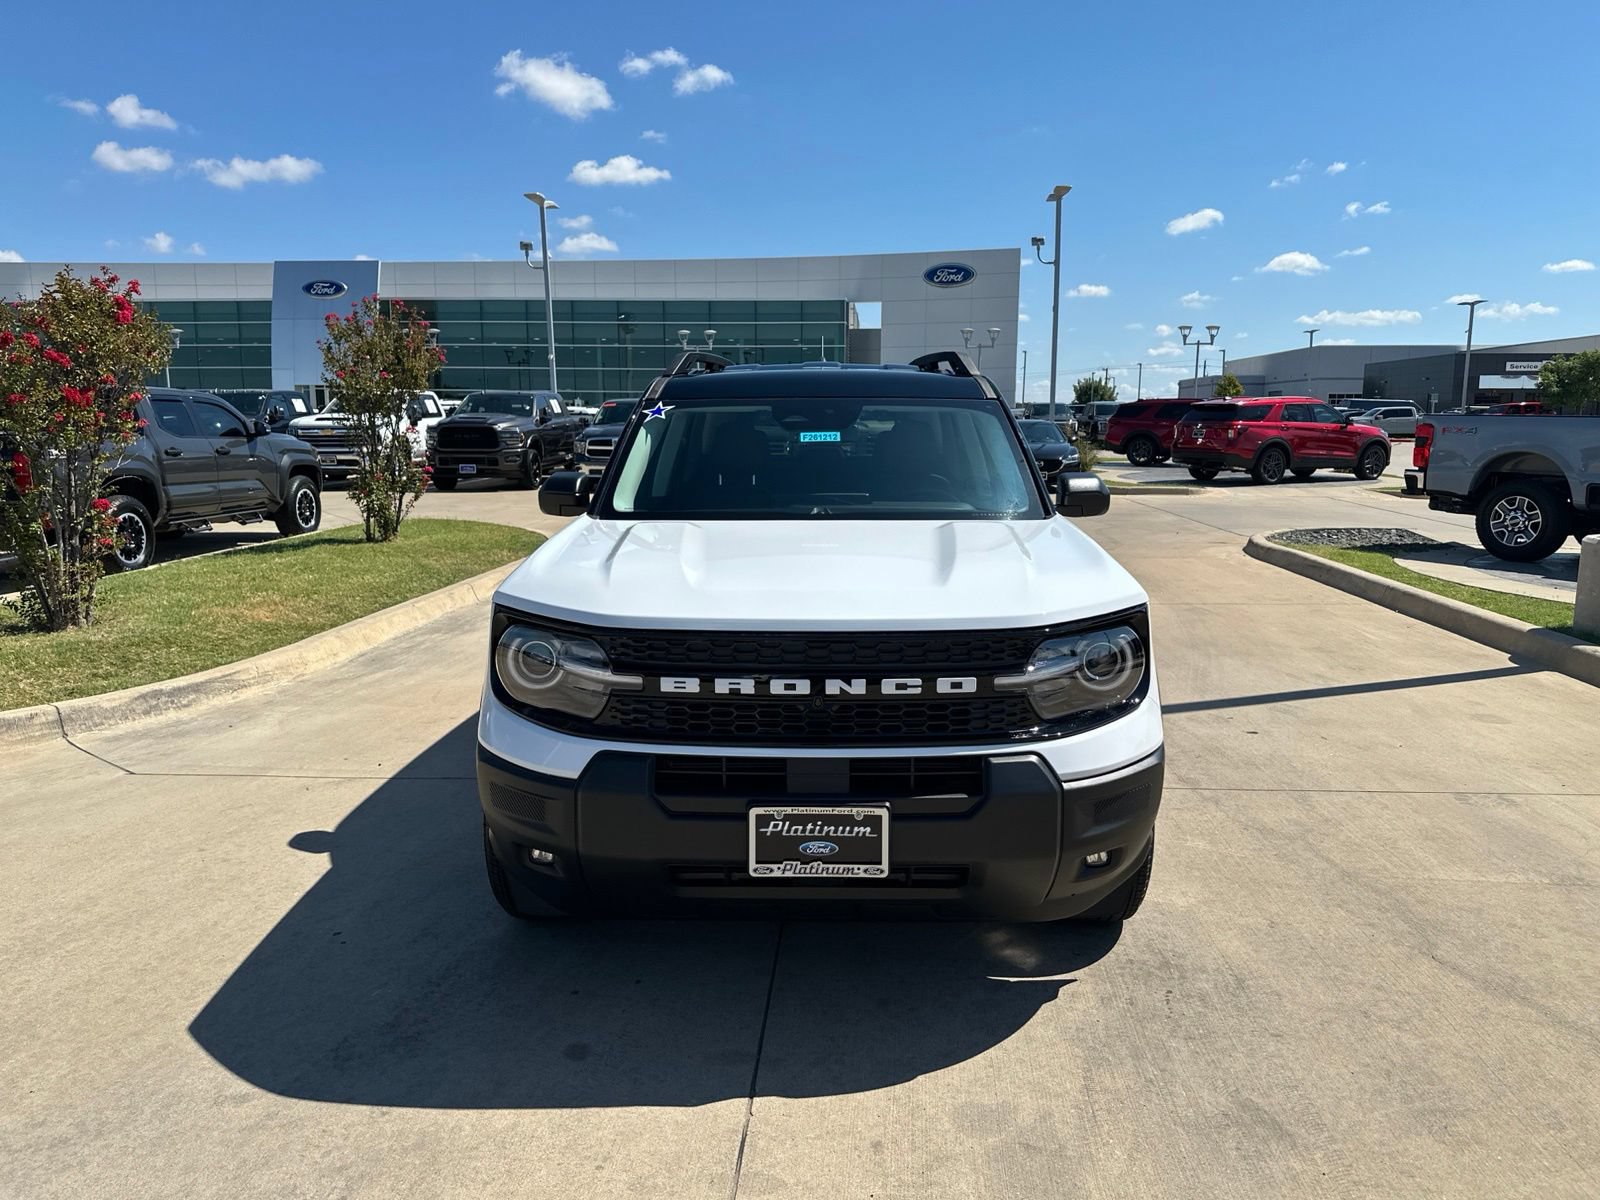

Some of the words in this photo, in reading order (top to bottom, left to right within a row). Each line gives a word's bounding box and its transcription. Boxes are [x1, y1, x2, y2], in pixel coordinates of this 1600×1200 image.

[933, 268, 965, 282] Ford
[310, 282, 336, 294] Ford
[802, 433, 838, 441] F261212
[660, 676, 977, 695] BRONCO
[763, 807, 876, 815] www.PlatinumFord.com
[759, 821, 878, 837] Platinum
[806, 842, 831, 854] Ford
[781, 862, 860, 876] Platinum
